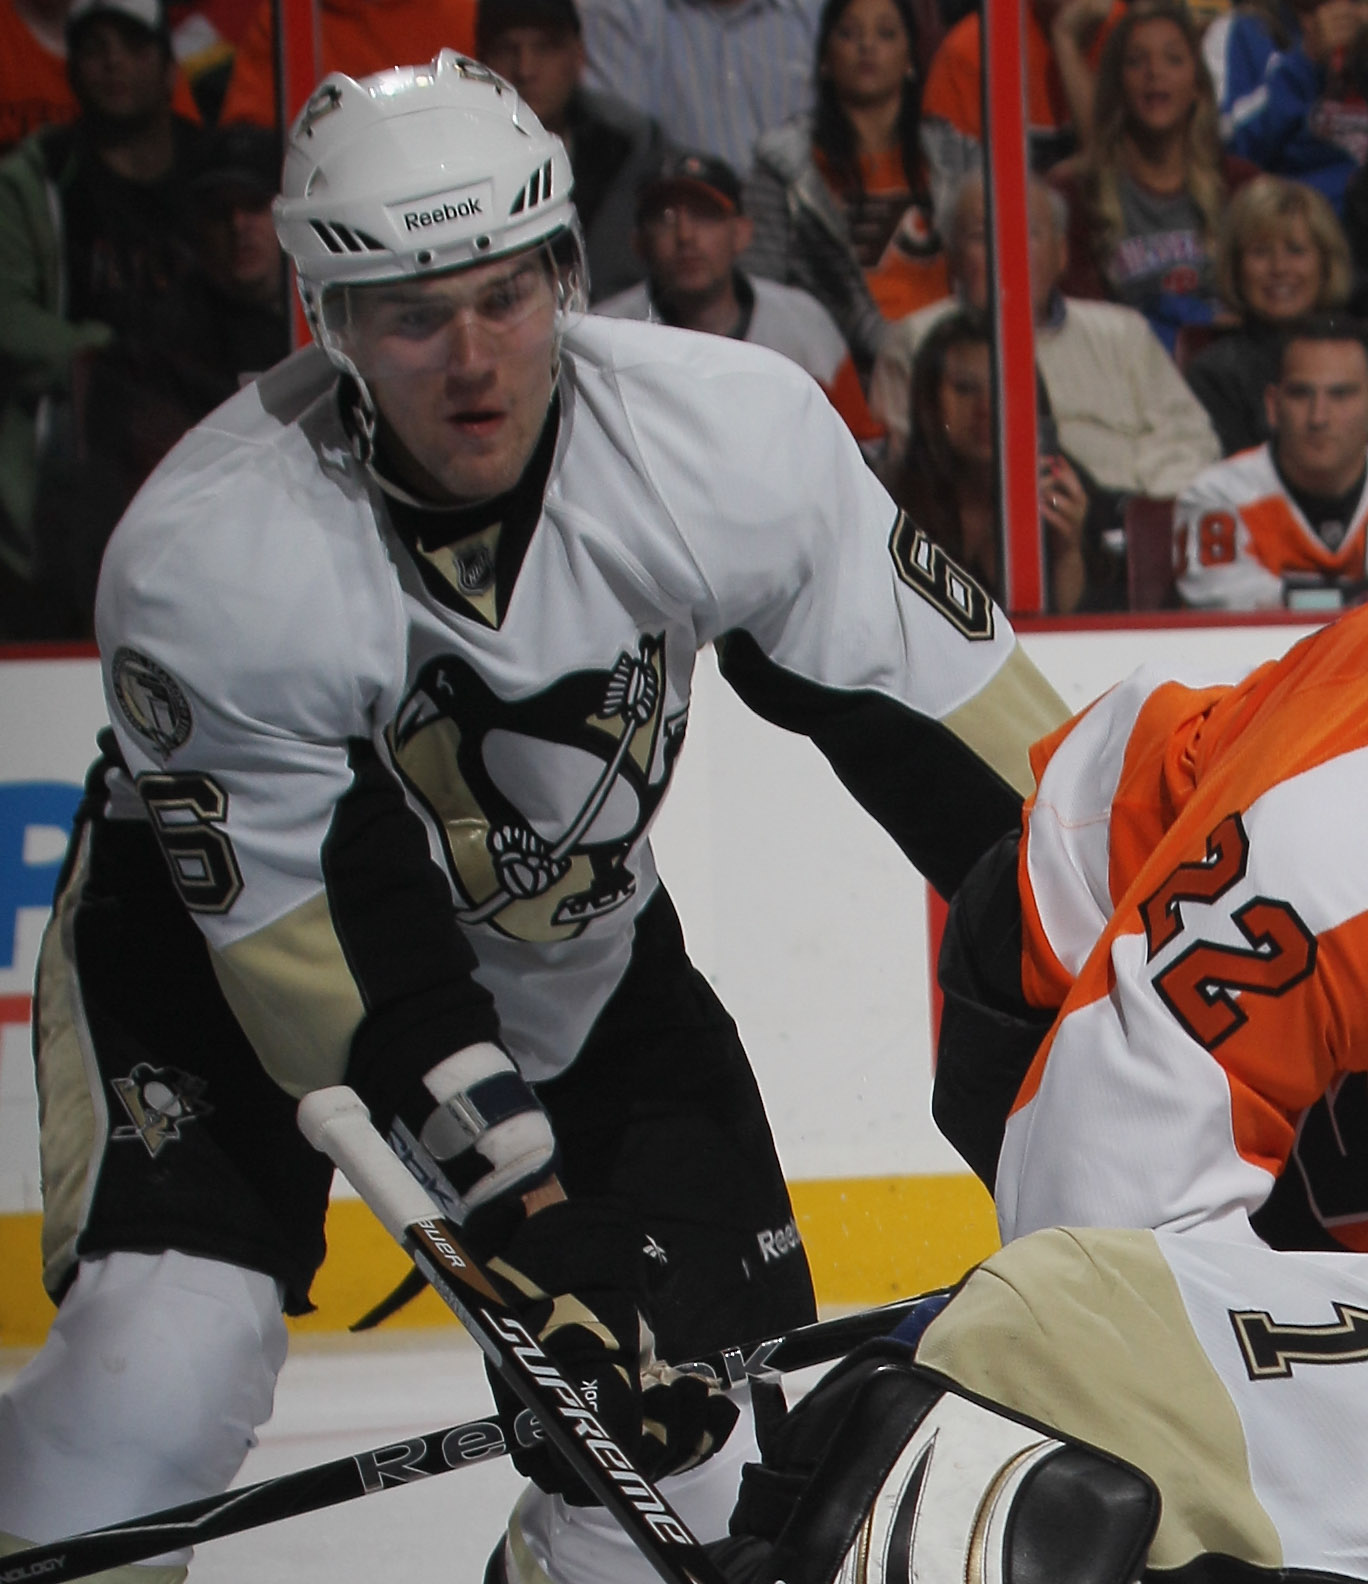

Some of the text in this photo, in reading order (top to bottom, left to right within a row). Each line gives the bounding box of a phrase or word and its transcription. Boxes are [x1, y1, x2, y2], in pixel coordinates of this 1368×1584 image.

[403, 198, 482, 231] Reebok
[136, 770, 245, 915] 6
[1137, 811, 1318, 1052] 22
